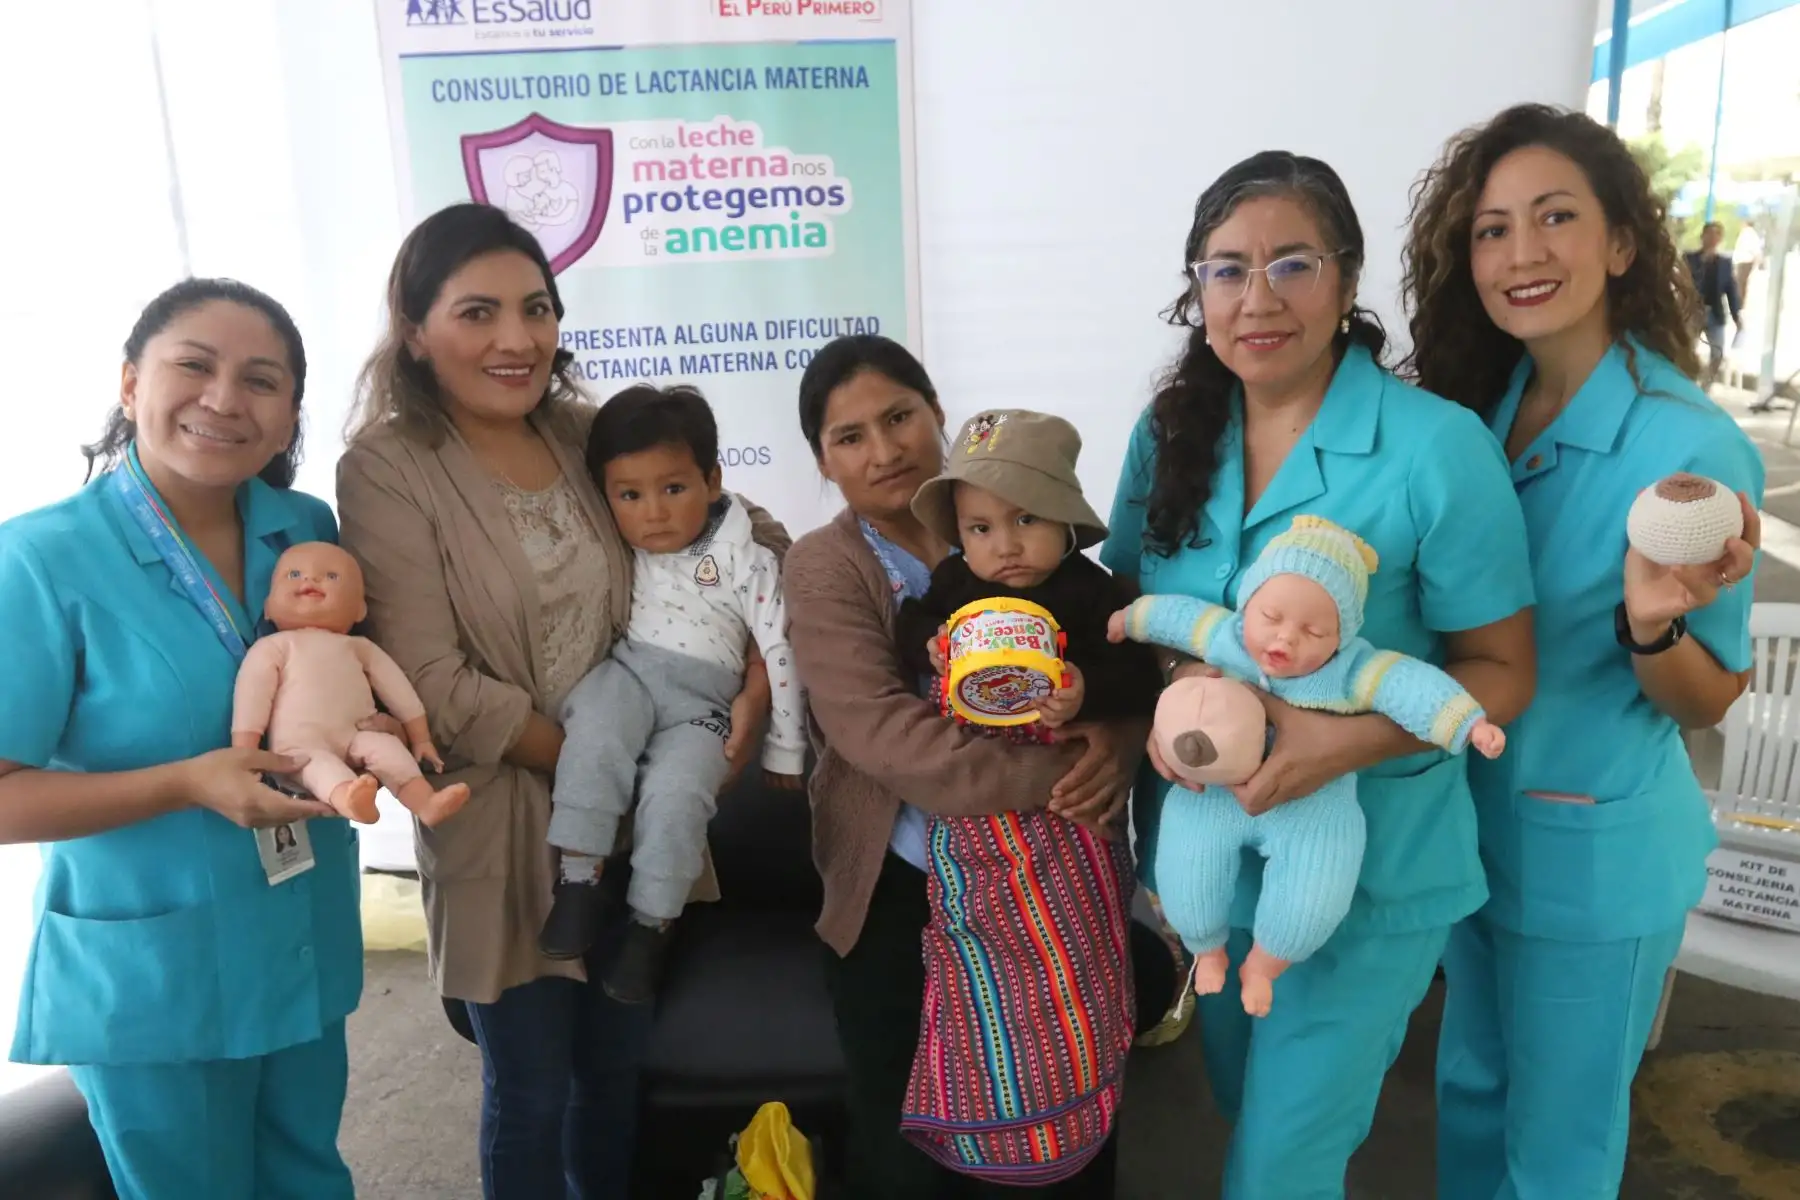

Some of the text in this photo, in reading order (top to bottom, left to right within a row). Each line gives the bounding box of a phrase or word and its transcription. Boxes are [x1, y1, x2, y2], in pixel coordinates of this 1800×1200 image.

[473, 0, 592, 23] EsSalud
[797, 0, 875, 16] PRIMERO
[549, 26, 594, 36] servicio
[431, 65, 870, 103] CONSULTORIO DE LACTANCIA MATERNA
[629, 124, 755, 150] Con la leche
[633, 153, 827, 182] materna nos
[622, 184, 845, 224] protegemos
[640, 210, 827, 255] de anemia
[644, 241, 658, 256] la
[560, 315, 881, 351] PRESENTA ALGUNA DIFICULTAD
[571, 347, 820, 381] ACTANCIA MATERNA CO
[716, 446, 772, 467] ADOS
[988, 635, 1042, 650] Baby
[1706, 867, 1795, 893] CONSEJERIA
[1739, 860, 1788, 877] KIT DE
[1718, 884, 1799, 908] LACTANCIA
[1722, 898, 1792, 920] MATERNA
